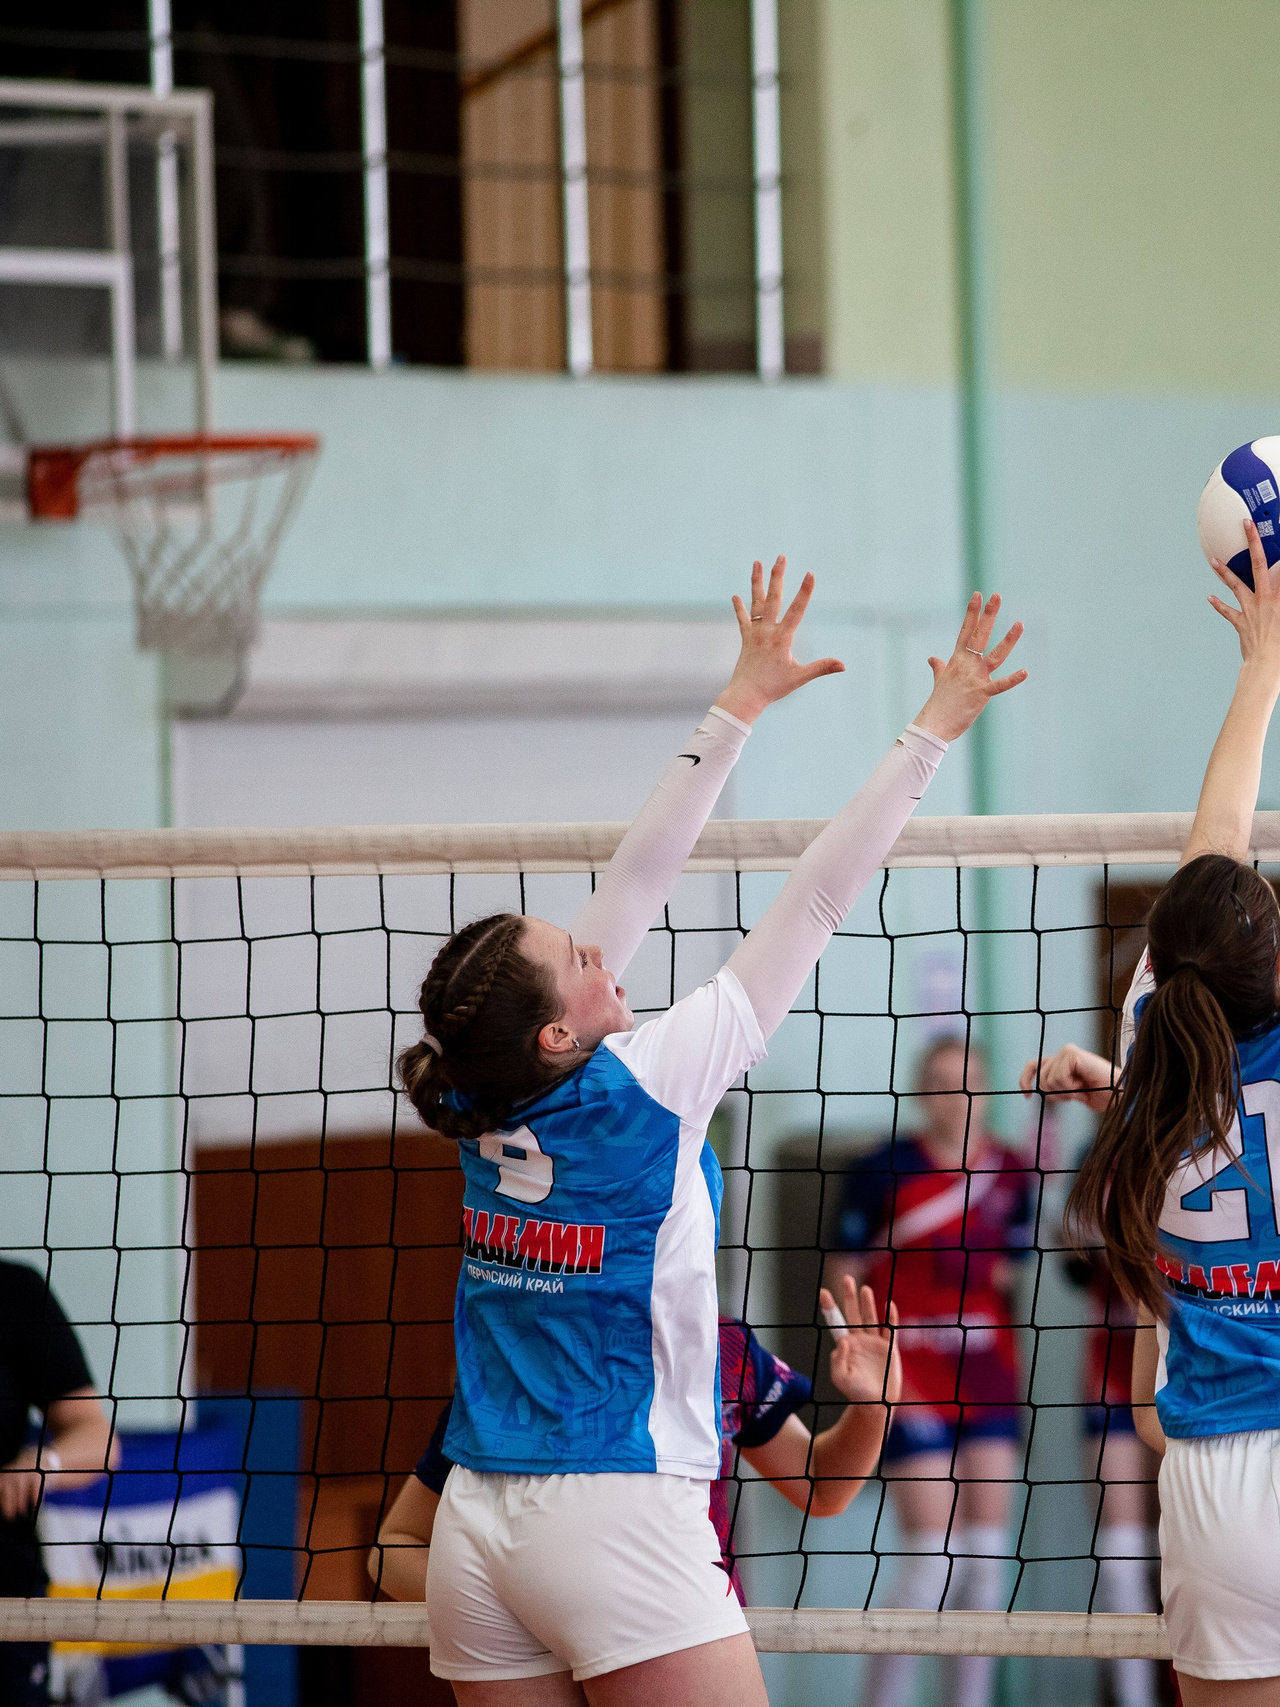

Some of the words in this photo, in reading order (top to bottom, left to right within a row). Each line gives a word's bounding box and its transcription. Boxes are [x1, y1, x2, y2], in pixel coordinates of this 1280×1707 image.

[462, 1204, 606, 1276] КАДЕМИЯ
[467, 1264, 523, 1289] ПЕРМСКИЙ
[525, 1277, 564, 1294] КРАЙ
[1198, 1300, 1269, 1317] МСКИЙ
